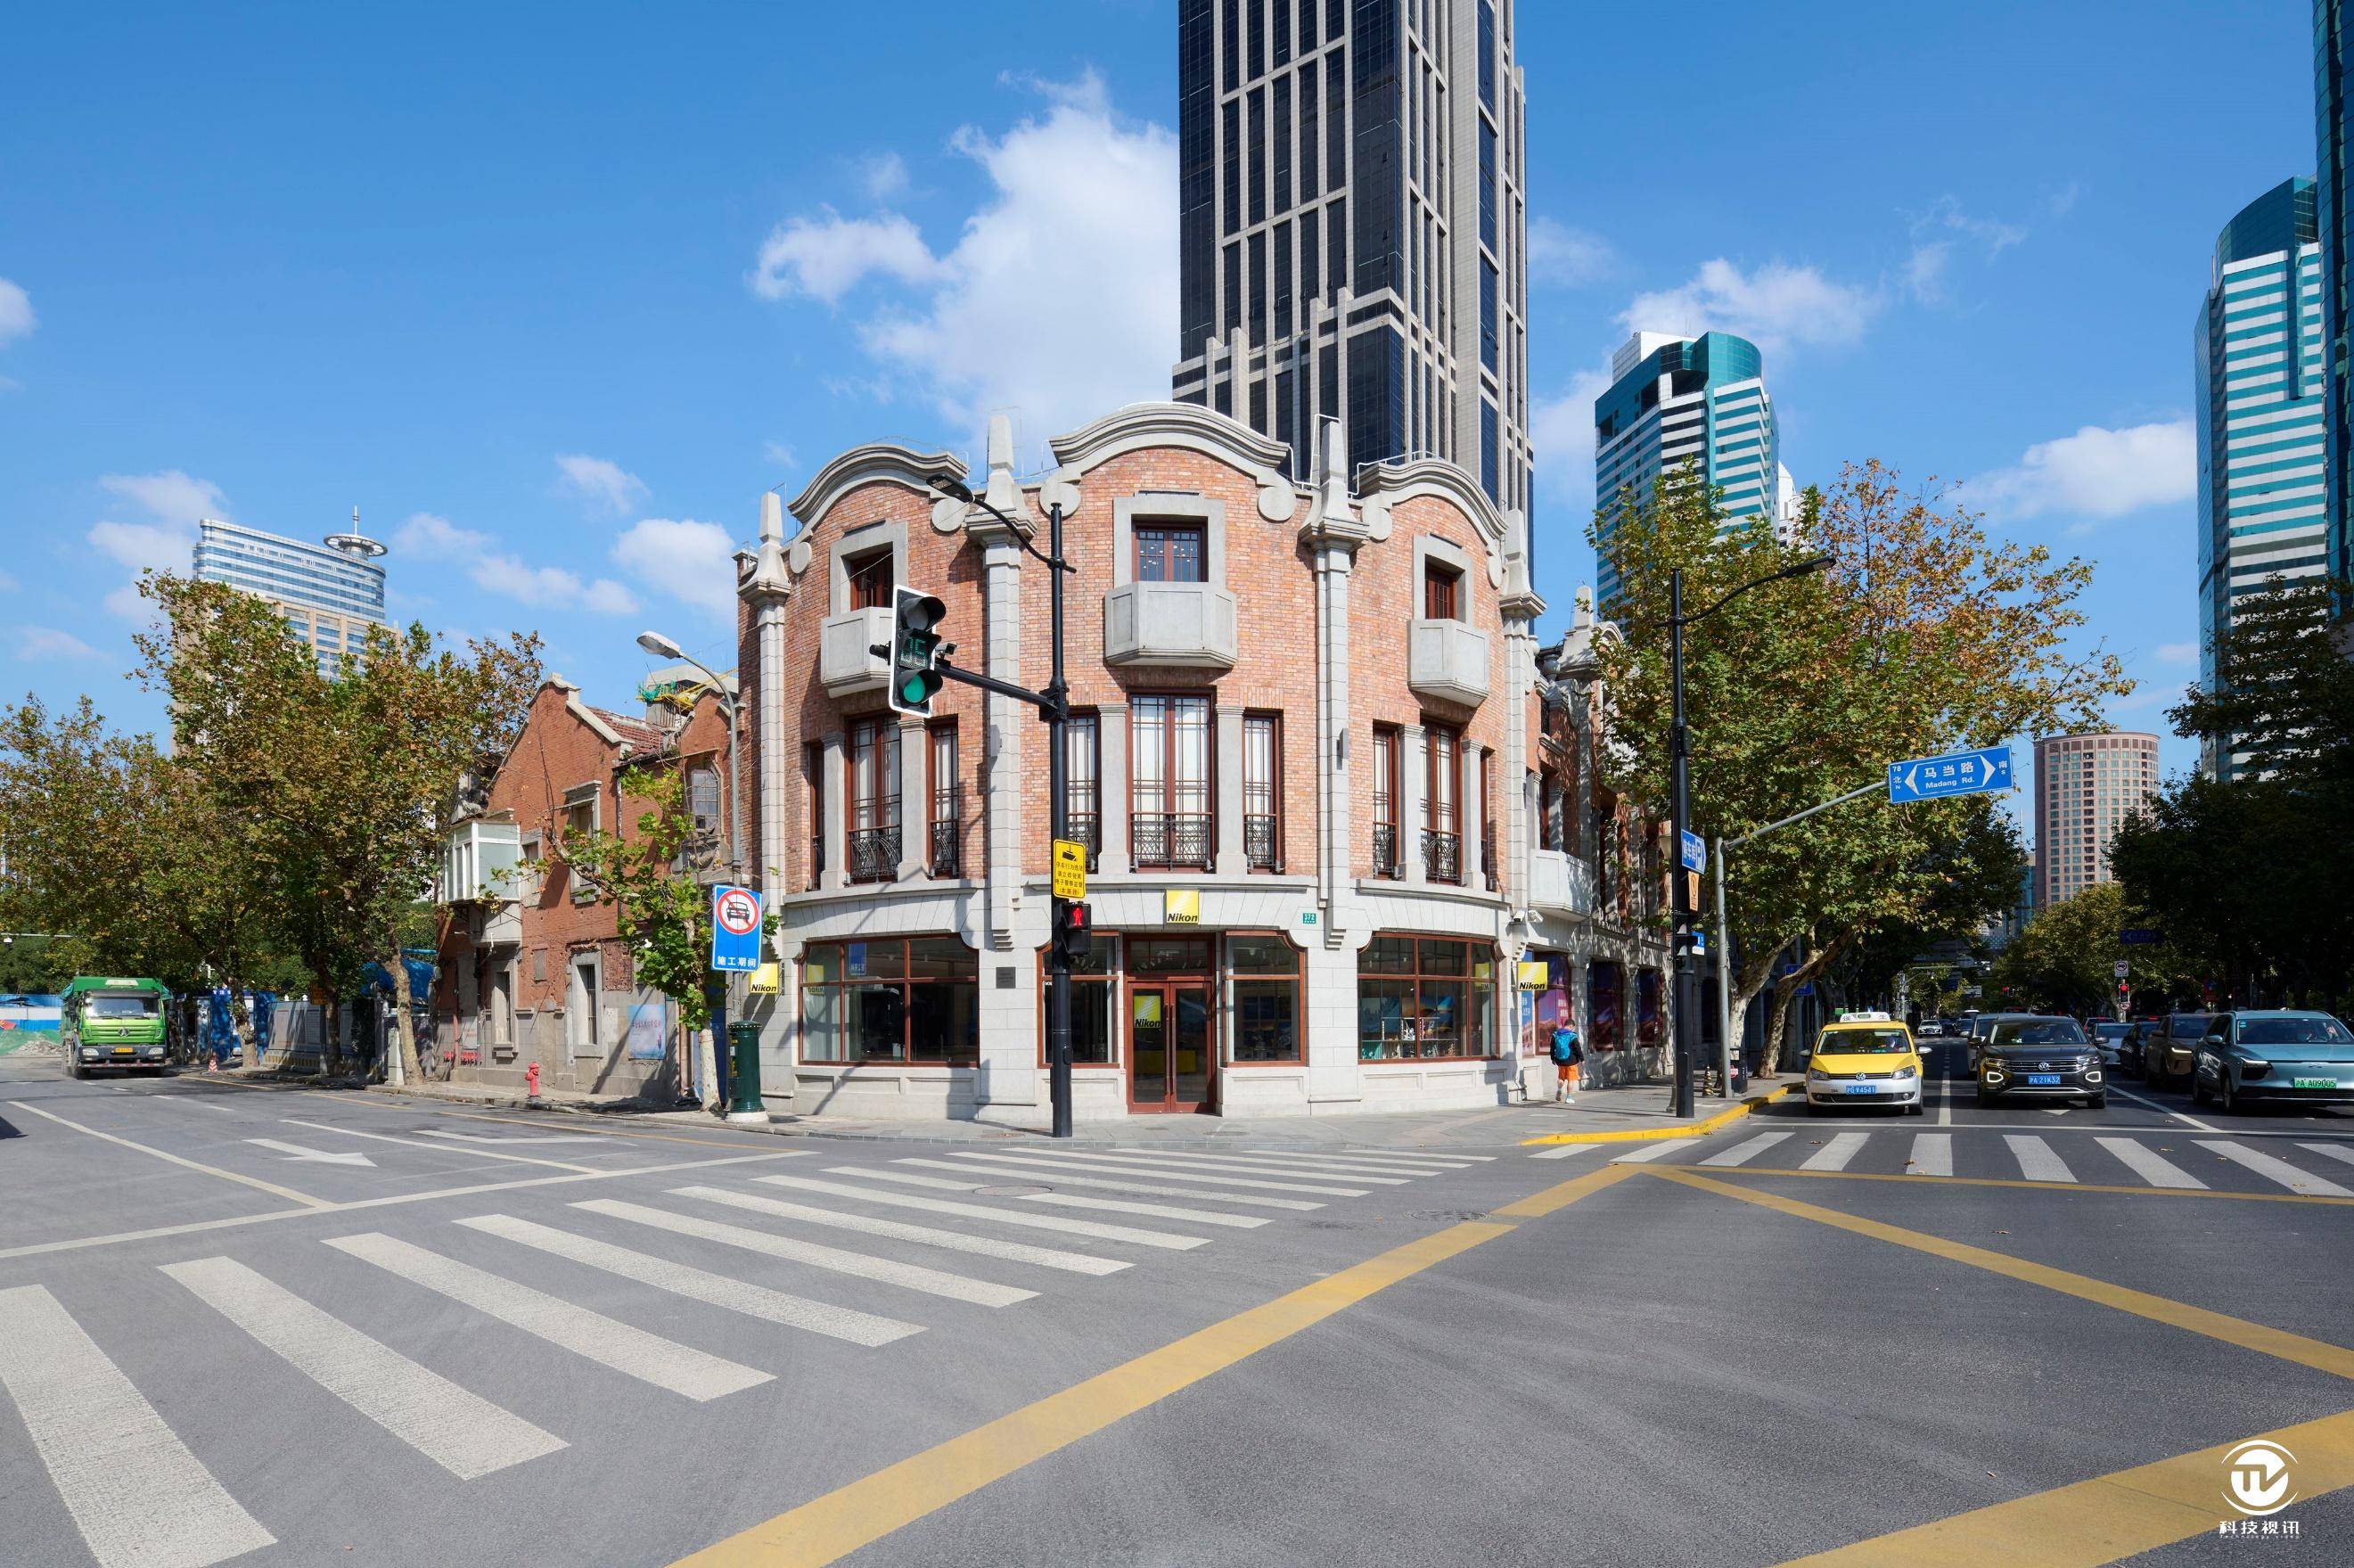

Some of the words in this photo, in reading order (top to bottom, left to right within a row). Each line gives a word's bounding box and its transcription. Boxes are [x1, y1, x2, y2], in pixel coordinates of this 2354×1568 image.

[1998, 760, 2007, 769] 南
[1924, 761, 1974, 778] 马当路
[1893, 776, 1902, 784] 北
[1925, 779, 1957, 790] Madang
[1167, 913, 1198, 922] Nikon
[717, 956, 757, 967] 施工期间
[750, 984, 777, 992] Nikon
[1519, 981, 1546, 989] Nikon
[1135, 1018, 1161, 1028] Nikon
